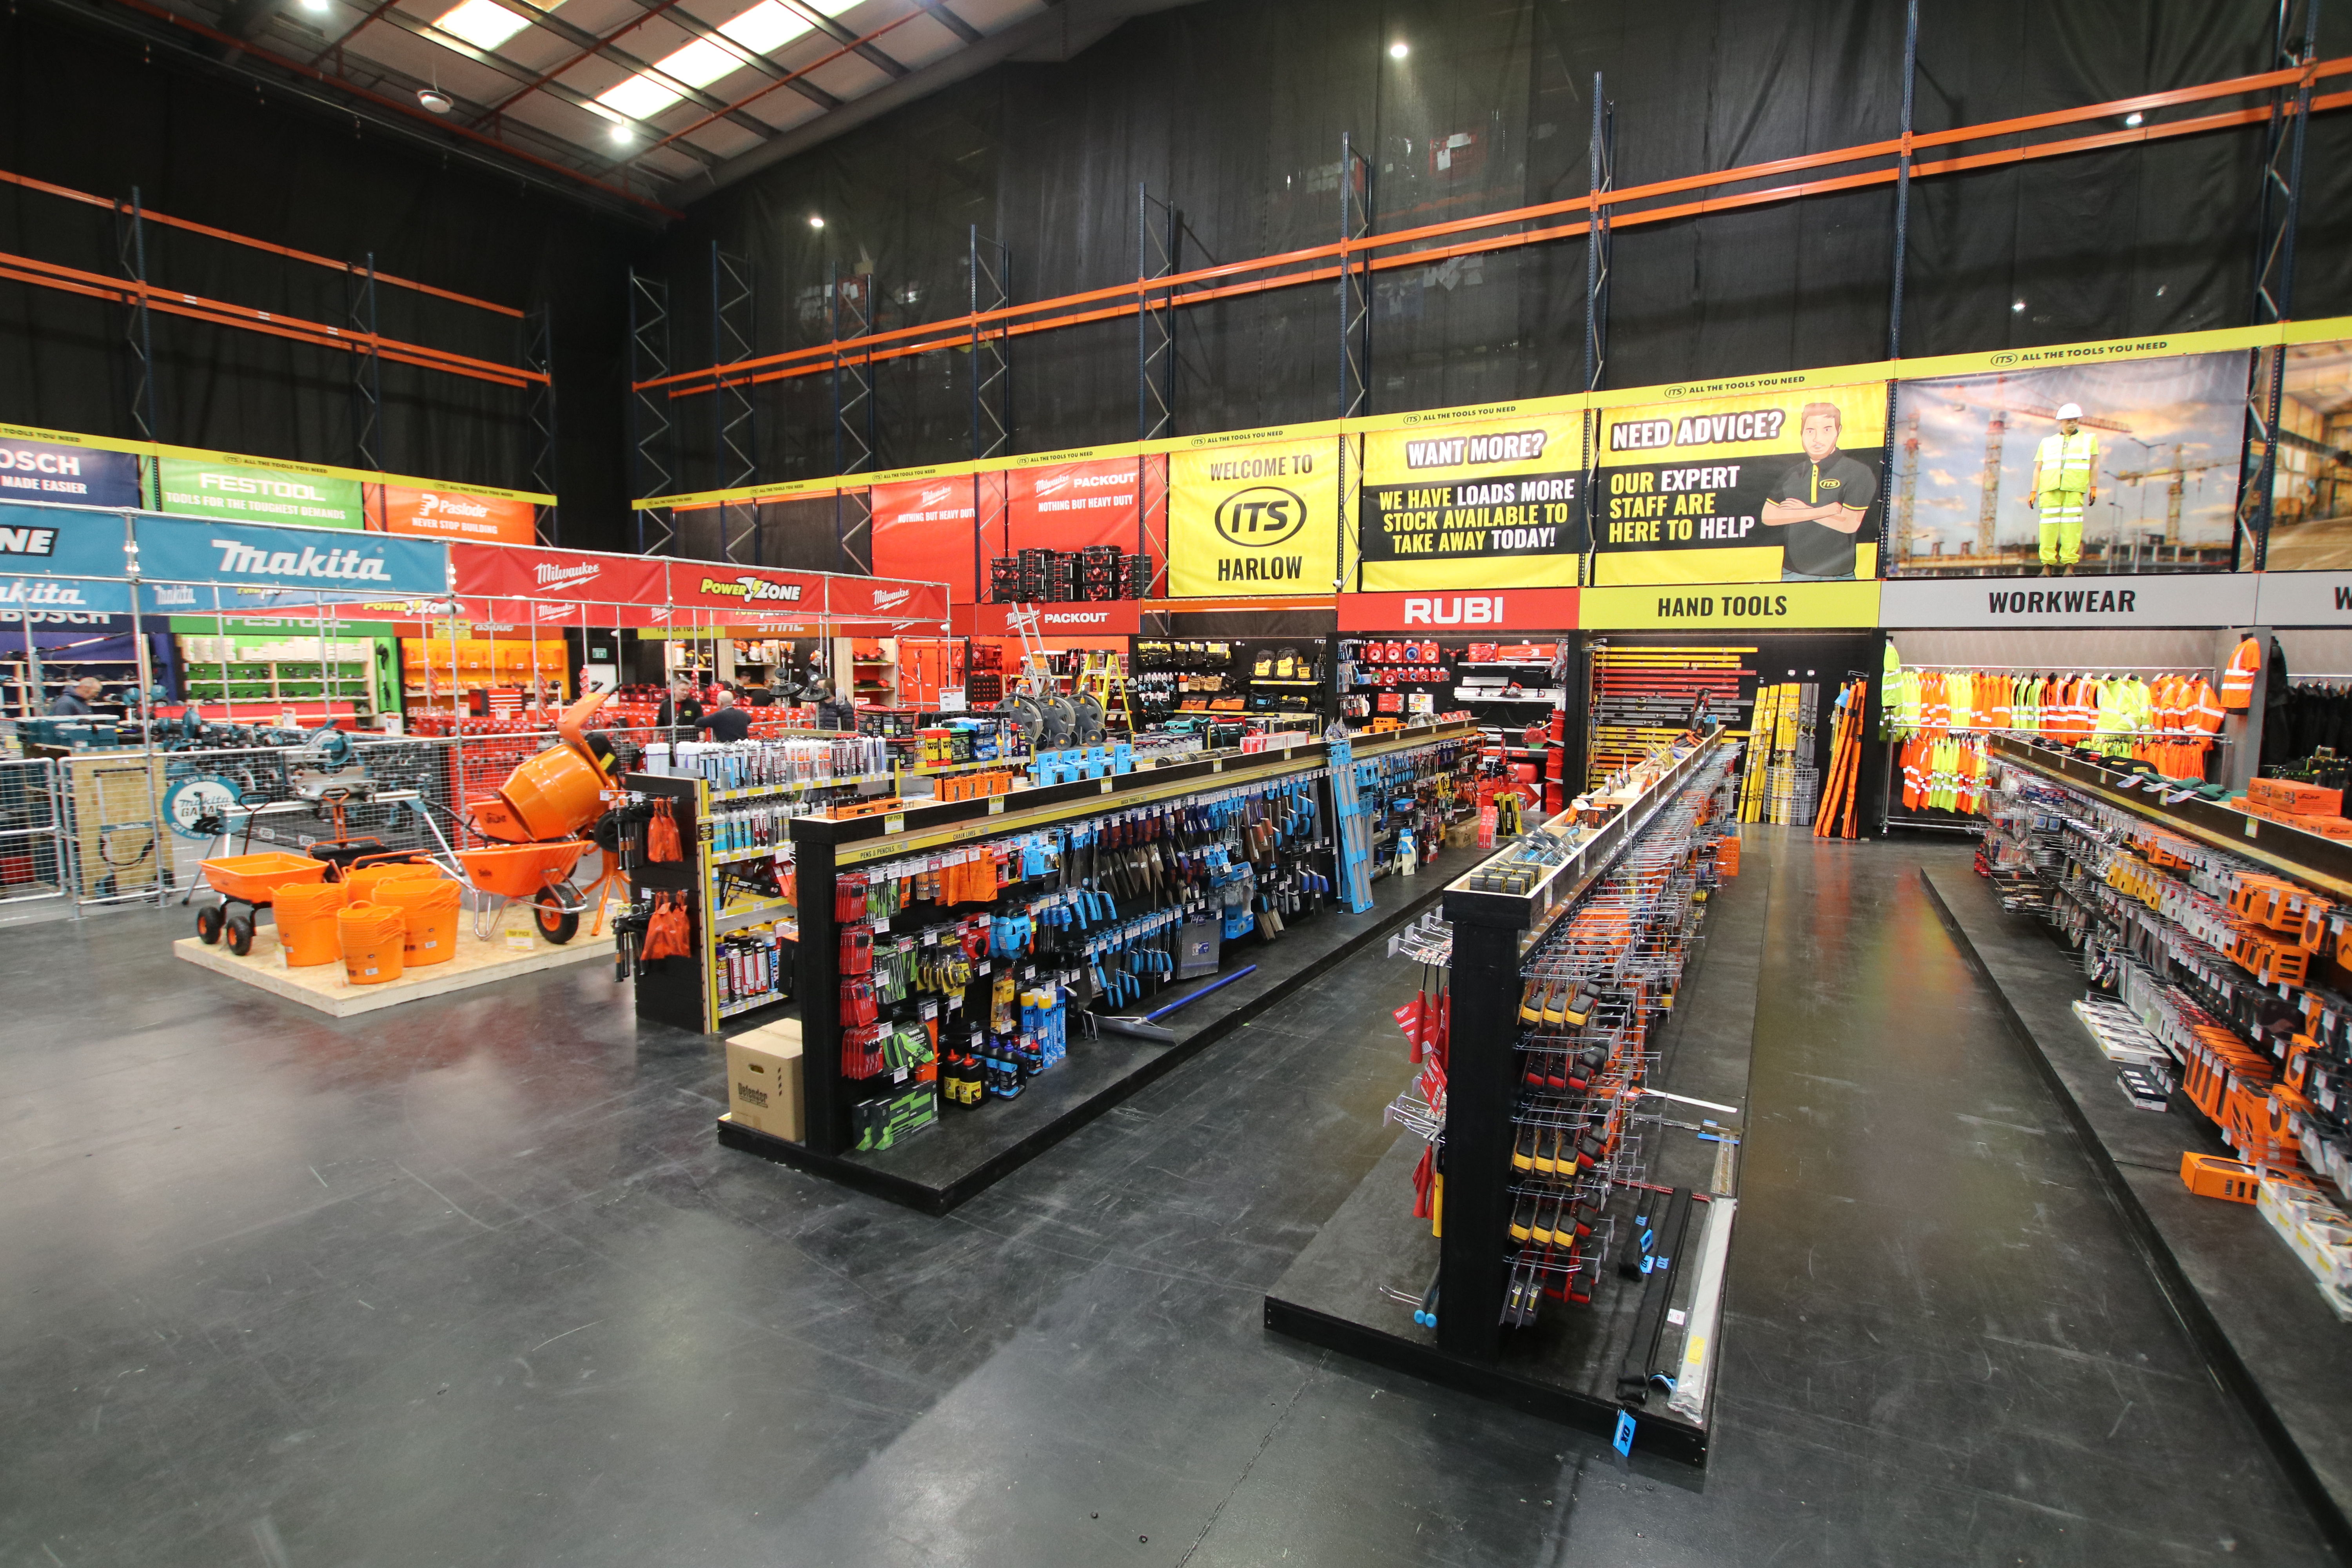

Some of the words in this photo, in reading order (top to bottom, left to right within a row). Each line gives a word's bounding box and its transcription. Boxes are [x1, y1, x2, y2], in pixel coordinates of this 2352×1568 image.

[1995, 354, 2013, 365] ITS
[2021, 352, 2042, 362] ALL
[2044, 350, 2064, 359] THE
[2067, 347, 2104, 358] TOOLS
[2107, 345, 2132, 354] YOU
[2136, 341, 2167, 351] NEED
[1725, 381, 1755, 390] TOOLS
[3, 428, 34, 437] TOOLS
[1613, 421, 1670, 449] NEED
[1678, 411, 1784, 444] ADVICE?
[1408, 440, 1464, 466] WANT
[1470, 433, 1544, 461] MORE?
[0, 448, 80, 475] OSCH
[1211, 456, 1286, 481] WELCOME
[1292, 454, 1313, 474] TO
[1, 475, 40, 489] MADE
[41, 479, 87, 494] EASIER
[200, 472, 326, 502] FESTOOL
[1035, 474, 1069, 493] Milwaukee
[1074, 473, 1135, 487] PACKOUT
[1611, 472, 1653, 495] OUR
[1661, 466, 1740, 492] EXPERT
[1822, 480, 1837, 488] ITS
[166, 492, 201, 505] TOOLS
[203, 495, 224, 507] FOR
[227, 498, 246, 509] THE
[248, 500, 299, 515] TOUGHEST
[301, 506, 345, 519] DEMANDS
[921, 486, 951, 503] Milwaukee
[1039, 500, 1069, 512] NOTHING
[1072, 499, 1086, 509] BUT
[1088, 497, 1111, 508] HEAVY
[1114, 495, 1133, 506] DUTY
[1379, 491, 1403, 510] WE
[1408, 488, 1451, 508] HAVE
[1457, 483, 1515, 505] LOADS
[1521, 479, 1575, 502] MORE
[439, 500, 488, 517] Paslode
[898, 512, 924, 523] NOTHING
[926, 511, 938, 521] BUT
[939, 510, 958, 519] HEAVY
[1232, 500, 1289, 533] ITS
[1610, 495, 1667, 519] STAFF
[1674, 493, 1716, 514] ARE
[412, 517, 438, 528] NEVER
[439, 520, 460, 530] STOP
[461, 523, 498, 534] BUILDING
[1384, 511, 1438, 532] STOCK
[1443, 506, 1540, 529] AVAILABLE
[1544, 503, 1568, 523] TO
[1393, 534, 1433, 554] TAKE
[1439, 531, 1486, 551] AWAY
[1492, 527, 1555, 549] TODAY!
[1609, 521, 1660, 543] HERE
[1667, 519, 1693, 540] TO
[1700, 516, 1755, 539] HELP
[0, 528, 54, 554] NE
[533, 562, 600, 584] Milwaukee
[1218, 556, 1302, 581] HARLOW
[701, 579, 746, 596] POWER
[759, 580, 801, 600] ZONE
[872, 588, 909, 606] Milwaukee
[537, 603, 575, 617] Milwaukee
[1404, 597, 1503, 624] RUBI
[1658, 598, 1713, 617] HAND
[1722, 596, 1788, 615] TOOLS
[1989, 590, 2135, 613] WORKWEAR
[1045, 612, 1107, 623] PACKOUT
[877, 846, 895, 855] PENCILS
[907, 1033, 925, 1043] PROSCRIBE
[738, 1083, 767, 1103] Defender
[1656, 1255, 1669, 1269] OX
[1621, 1424, 1630, 1446] OX
